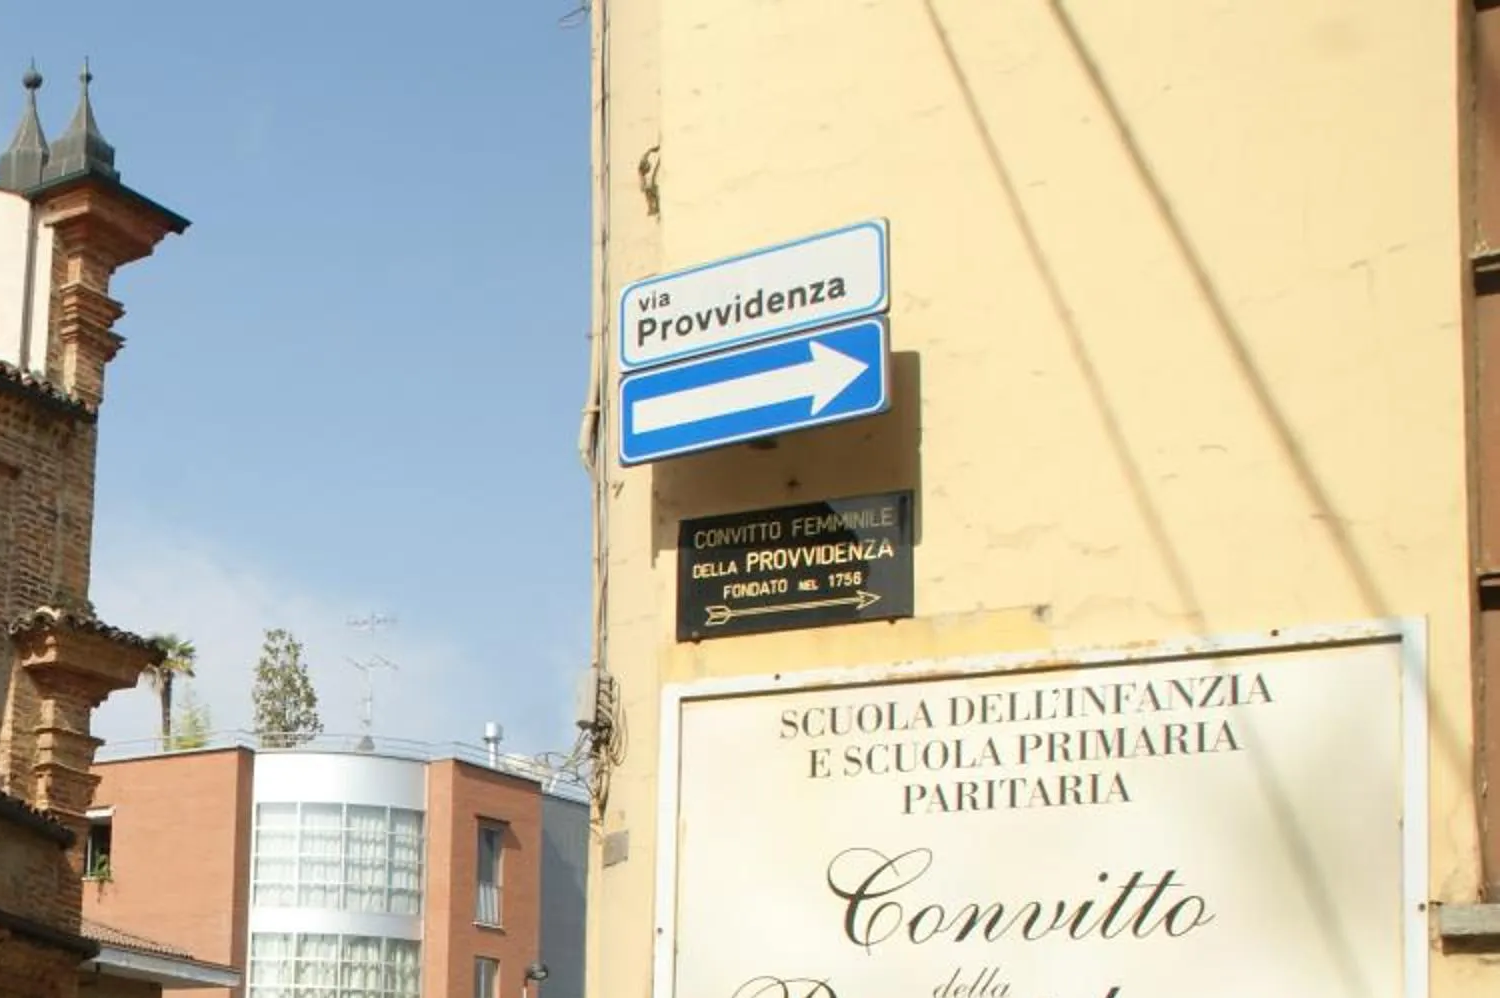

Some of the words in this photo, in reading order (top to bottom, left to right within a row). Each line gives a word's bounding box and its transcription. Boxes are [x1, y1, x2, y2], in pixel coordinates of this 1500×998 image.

[637, 276, 846, 347] Provvidenza
[638, 290, 671, 313] via
[693, 521, 782, 550] CONVITTO
[791, 507, 895, 538] FEMMINILE
[692, 561, 738, 580] DELLA
[746, 537, 895, 573] PROVVIDENZA
[723, 578, 789, 600] FONDATO
[798, 580, 820, 592] NEL
[779, 698, 935, 741] SCUOLA
[948, 672, 1276, 728] DELL'INFANZIA
[808, 747, 833, 780] E
[842, 737, 1003, 779] SCUOLA
[1014, 719, 1245, 766] PRIMARIA
[901, 771, 1132, 815] PARITARIA
[826, 846, 1217, 956] Convitto
